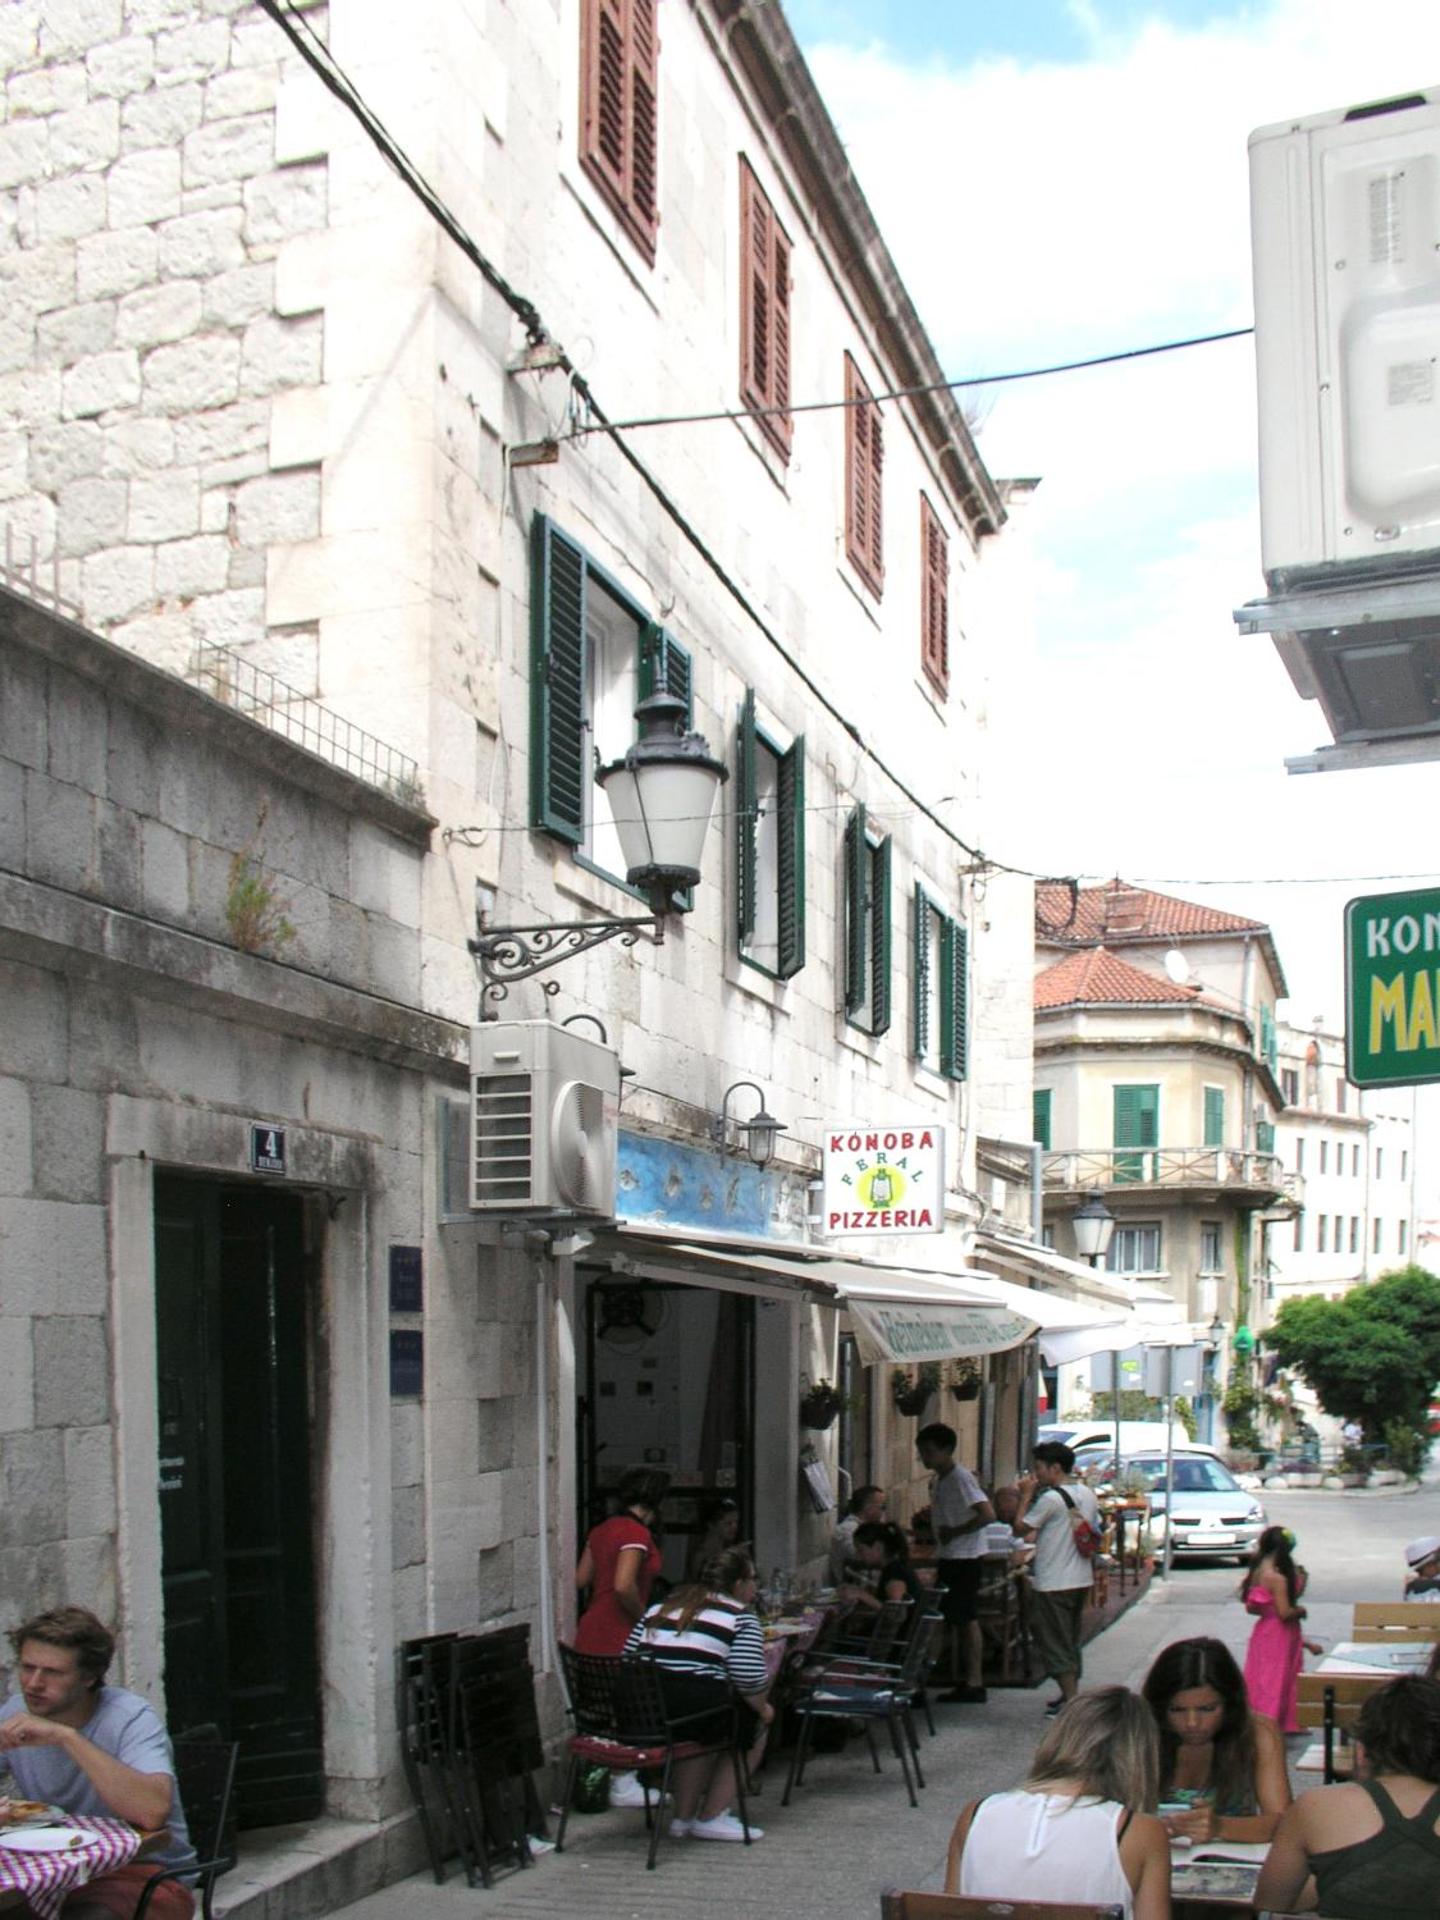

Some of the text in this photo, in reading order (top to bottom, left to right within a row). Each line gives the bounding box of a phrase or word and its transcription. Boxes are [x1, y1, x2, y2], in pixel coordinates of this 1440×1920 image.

[1368, 967, 1440, 1055] MA
[265, 1131, 277, 1158] 4
[830, 1131, 933, 1153] KONOBA
[841, 1152, 923, 1186] FERAL
[829, 1209, 932, 1230] PIZZERIA
